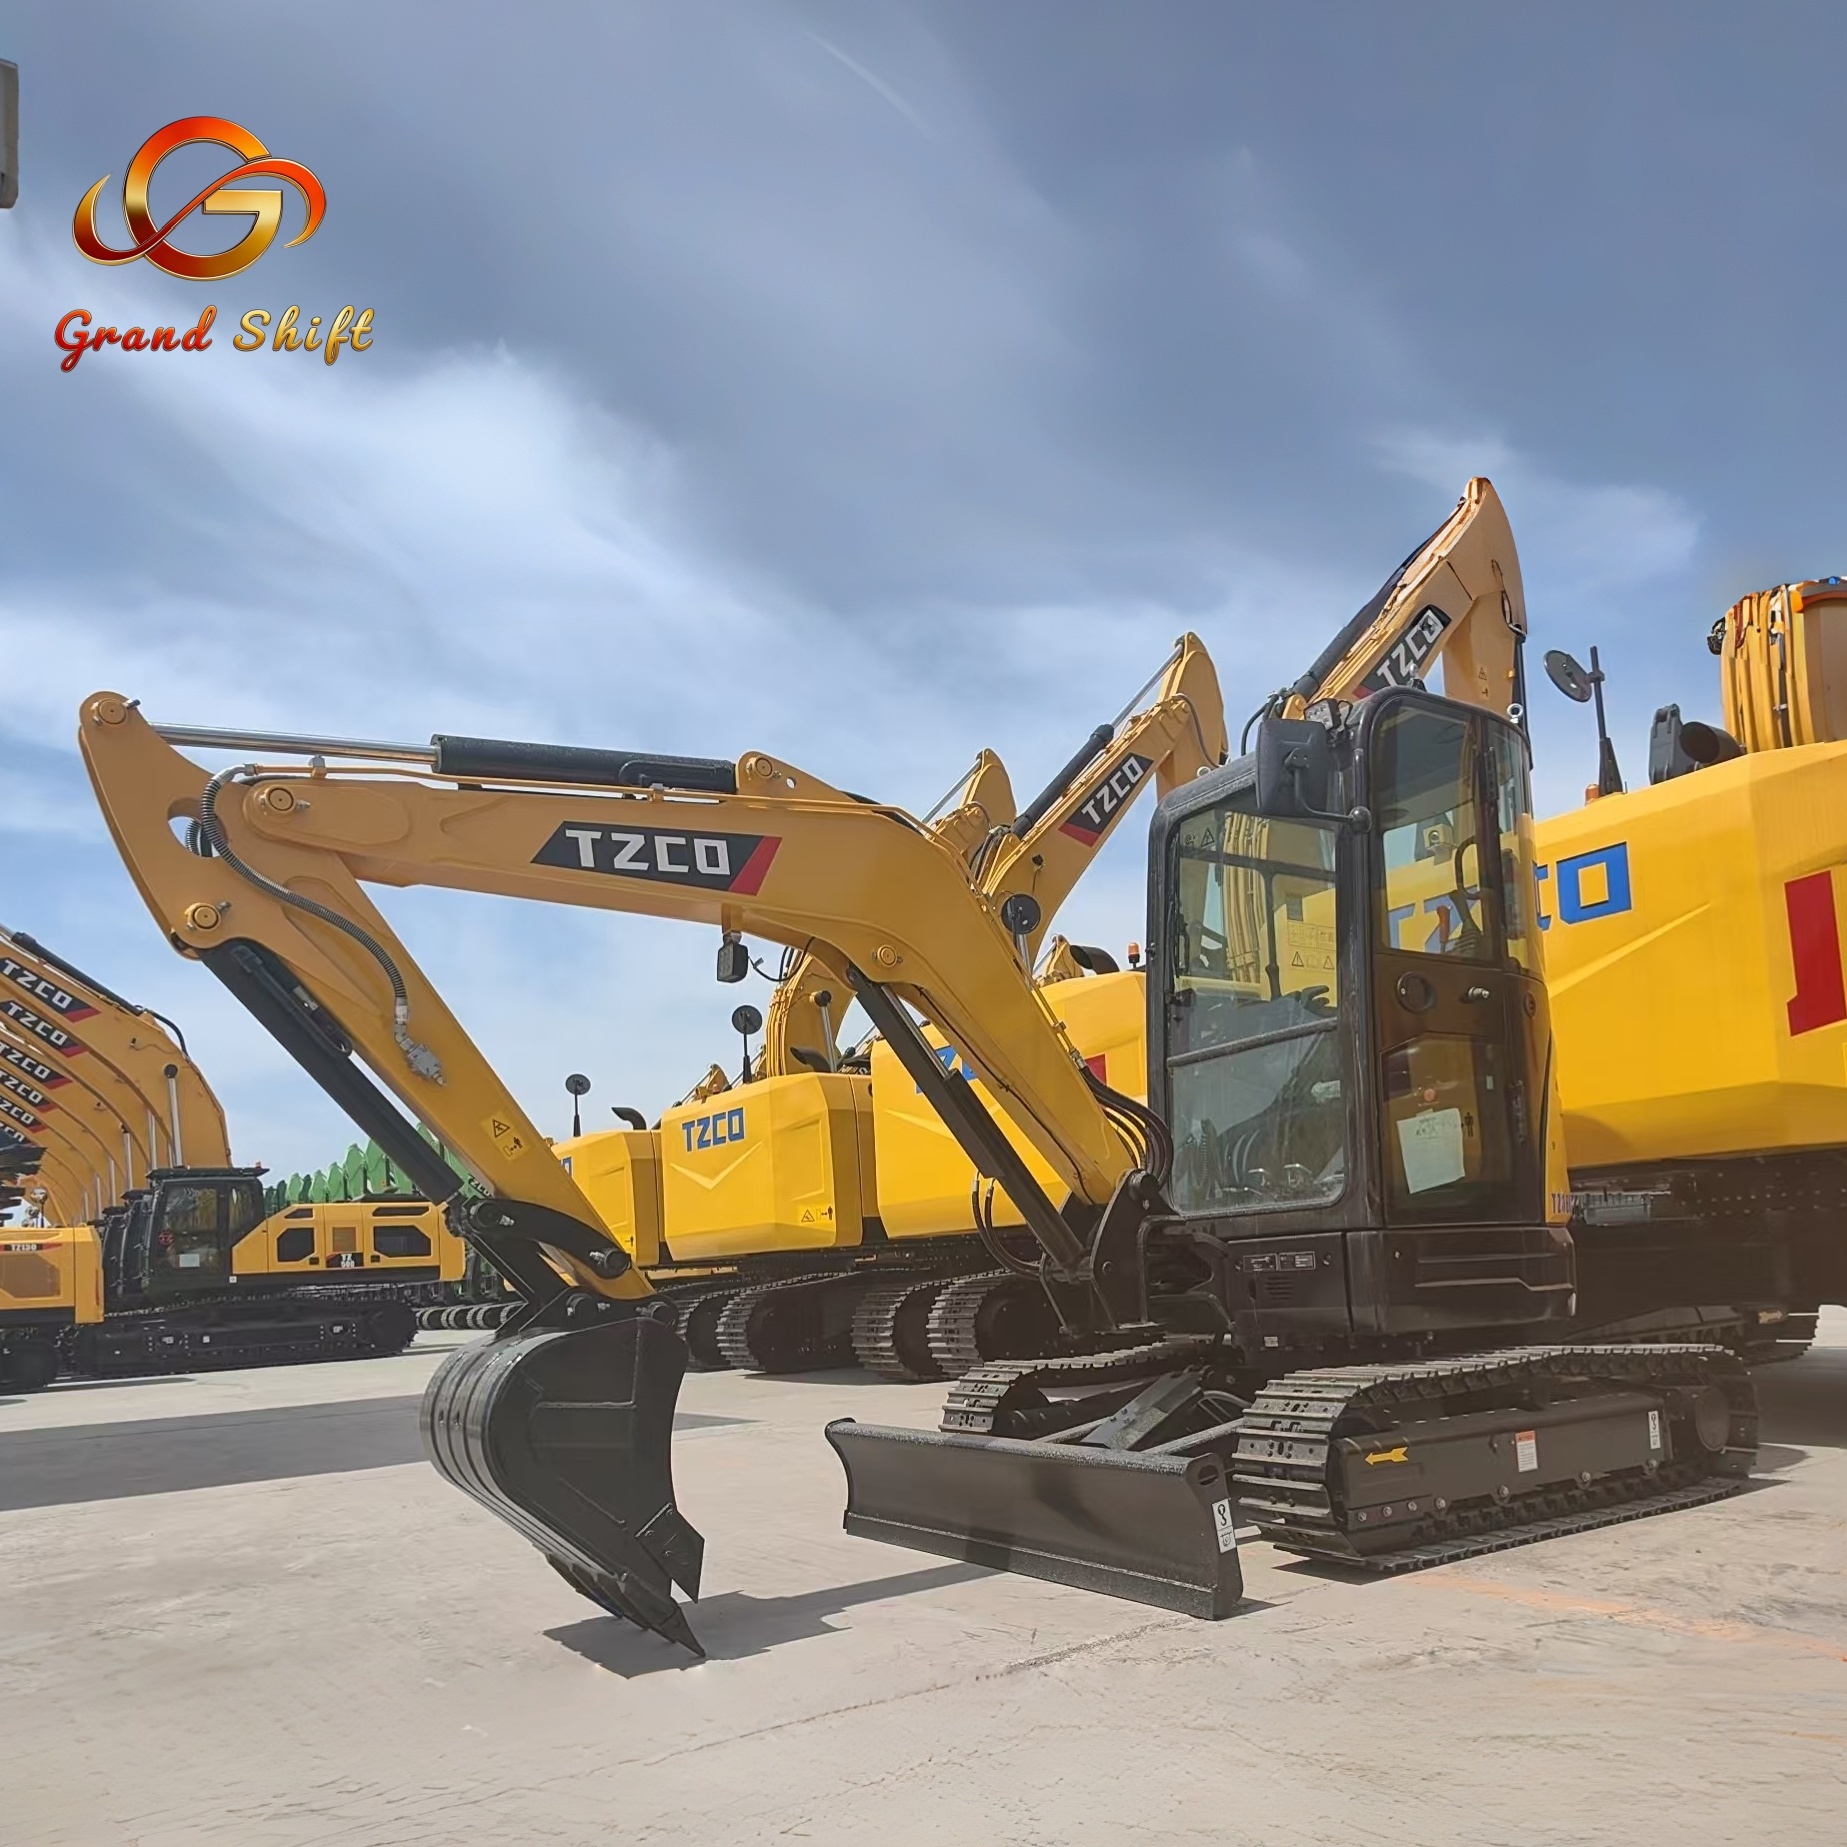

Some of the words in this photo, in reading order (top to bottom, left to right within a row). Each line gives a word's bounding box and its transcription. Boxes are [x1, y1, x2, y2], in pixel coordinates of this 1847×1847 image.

[1081, 756, 1144, 824] TZCO
[565, 829, 730, 876] TZCO
[3, 959, 73, 1009] TZCO
[7, 1002, 68, 1046] TZCO
[0, 1096, 34, 1124] ZCO
[682, 1107, 745, 1152] TZCO
